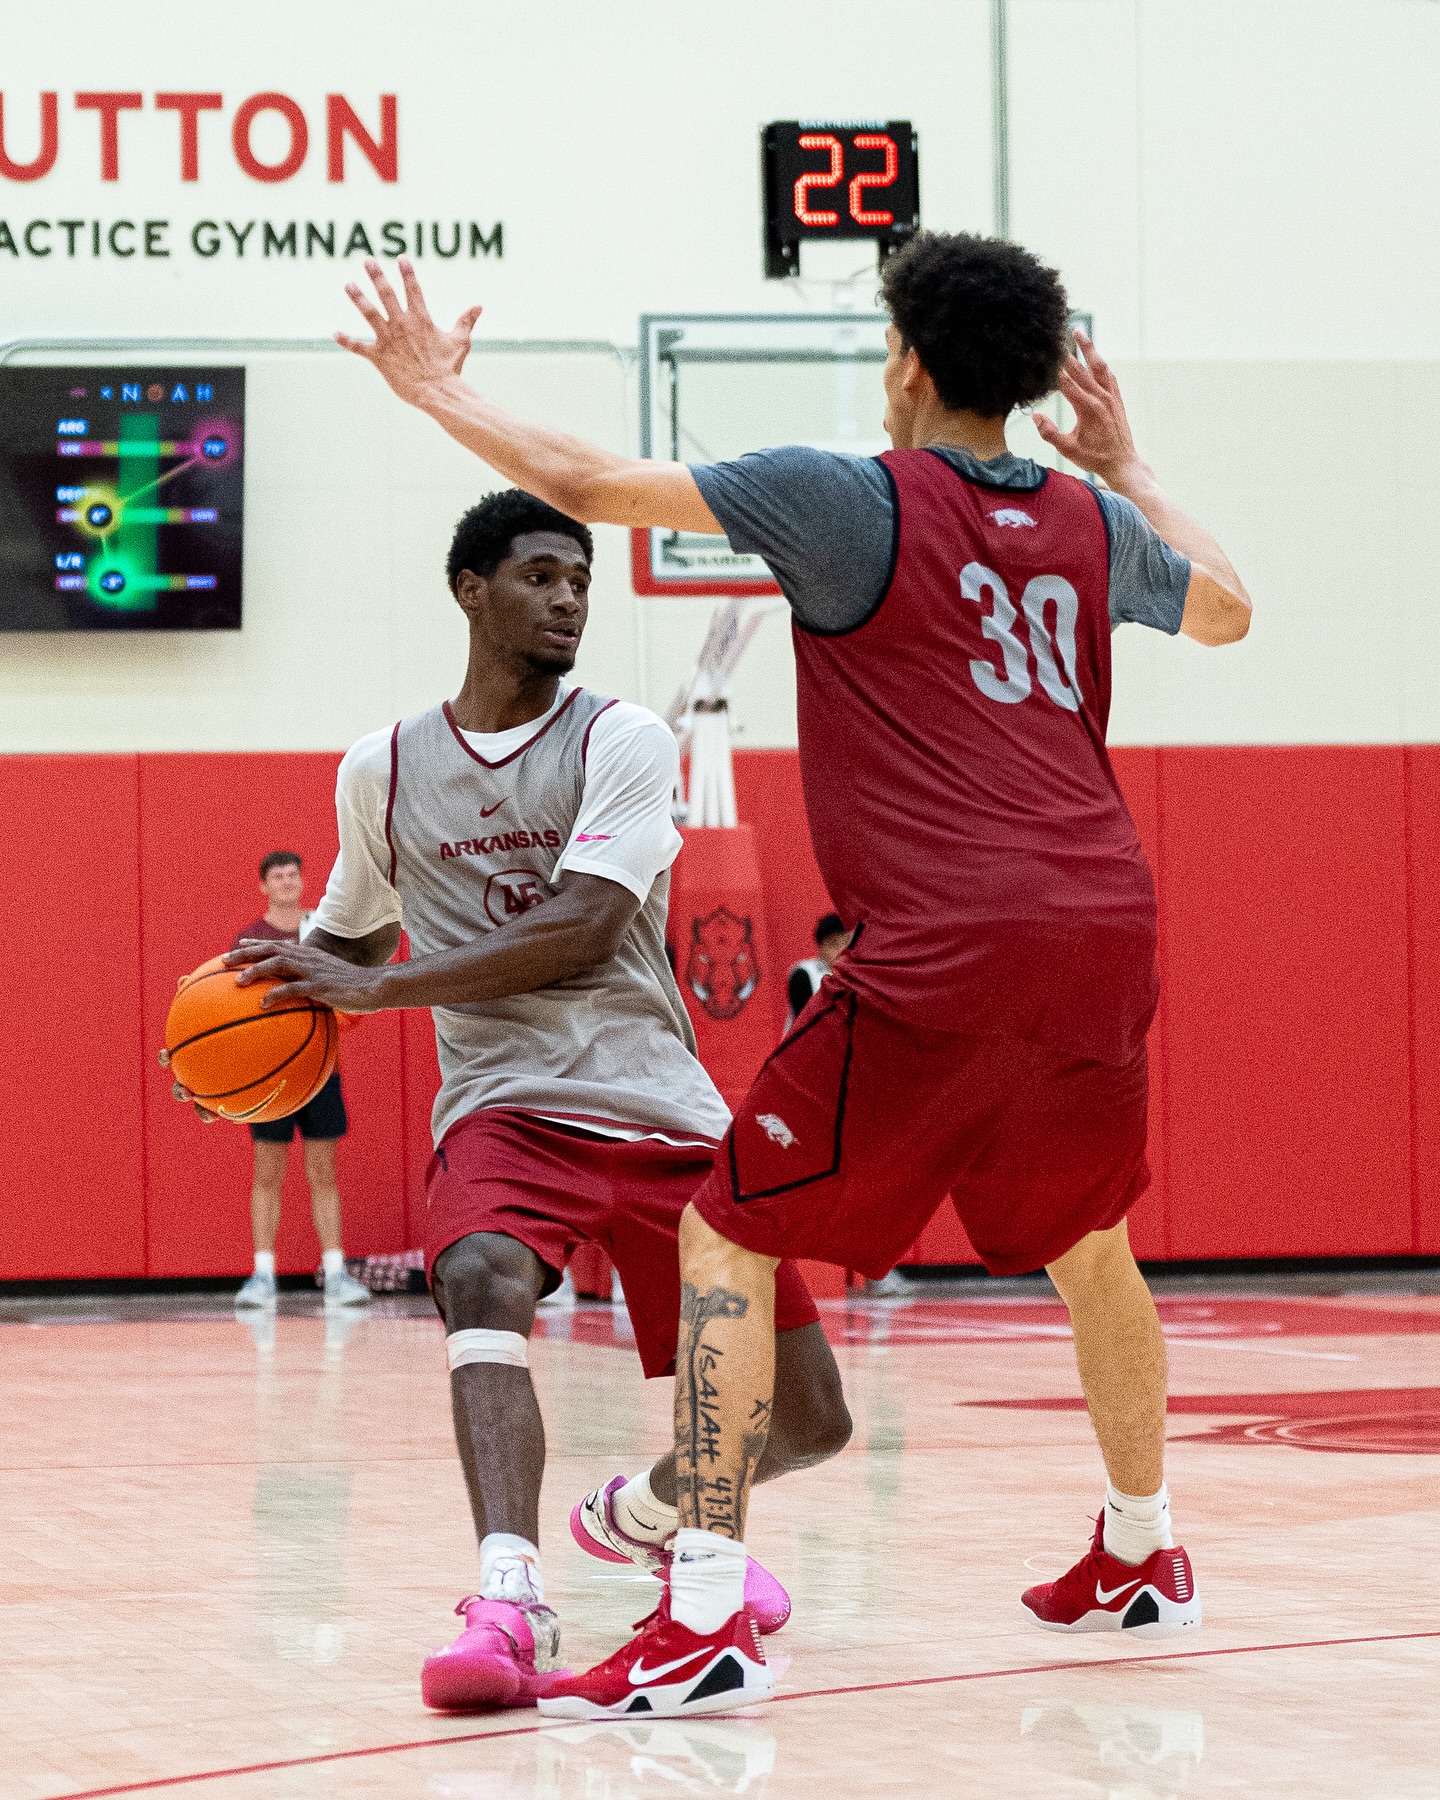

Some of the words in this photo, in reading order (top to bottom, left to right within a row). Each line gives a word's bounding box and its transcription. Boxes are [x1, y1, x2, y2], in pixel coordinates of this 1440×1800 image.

[0, 91, 398, 183] UTTON
[794, 134, 898, 226] 22
[191, 220, 504, 258] GYMNASIUM
[959, 561, 1084, 712] 30
[439, 829, 560, 861] ARKANSAS
[500, 881, 544, 915] 45
[700, 1344, 724, 1463] ISAIAH
